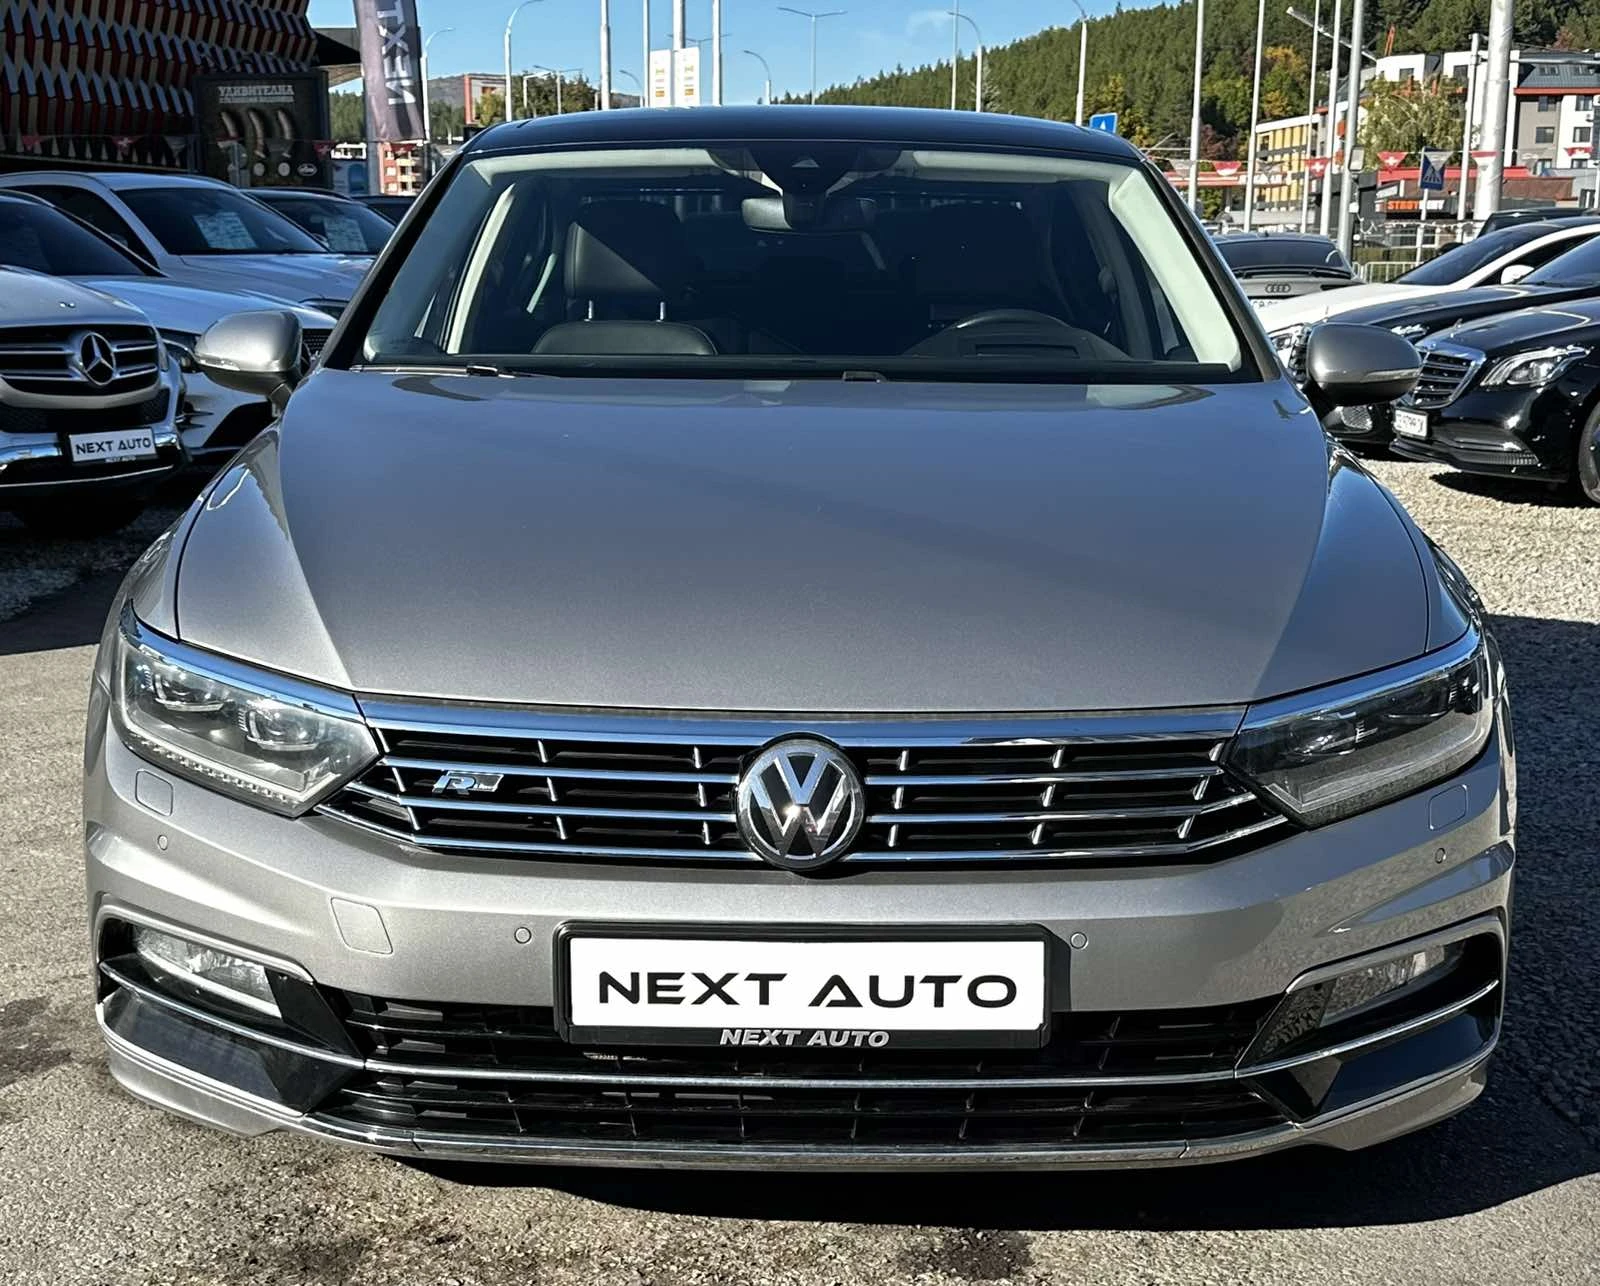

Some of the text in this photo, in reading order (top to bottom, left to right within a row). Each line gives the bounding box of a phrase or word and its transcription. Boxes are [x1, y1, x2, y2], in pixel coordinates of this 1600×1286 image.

[376, 0, 416, 105] NEXT
[75, 437, 151, 455] NEXT AUTO
[599, 971, 1017, 1009] NEXT AUTO
[719, 1028, 890, 1048] NEXT AUTO
